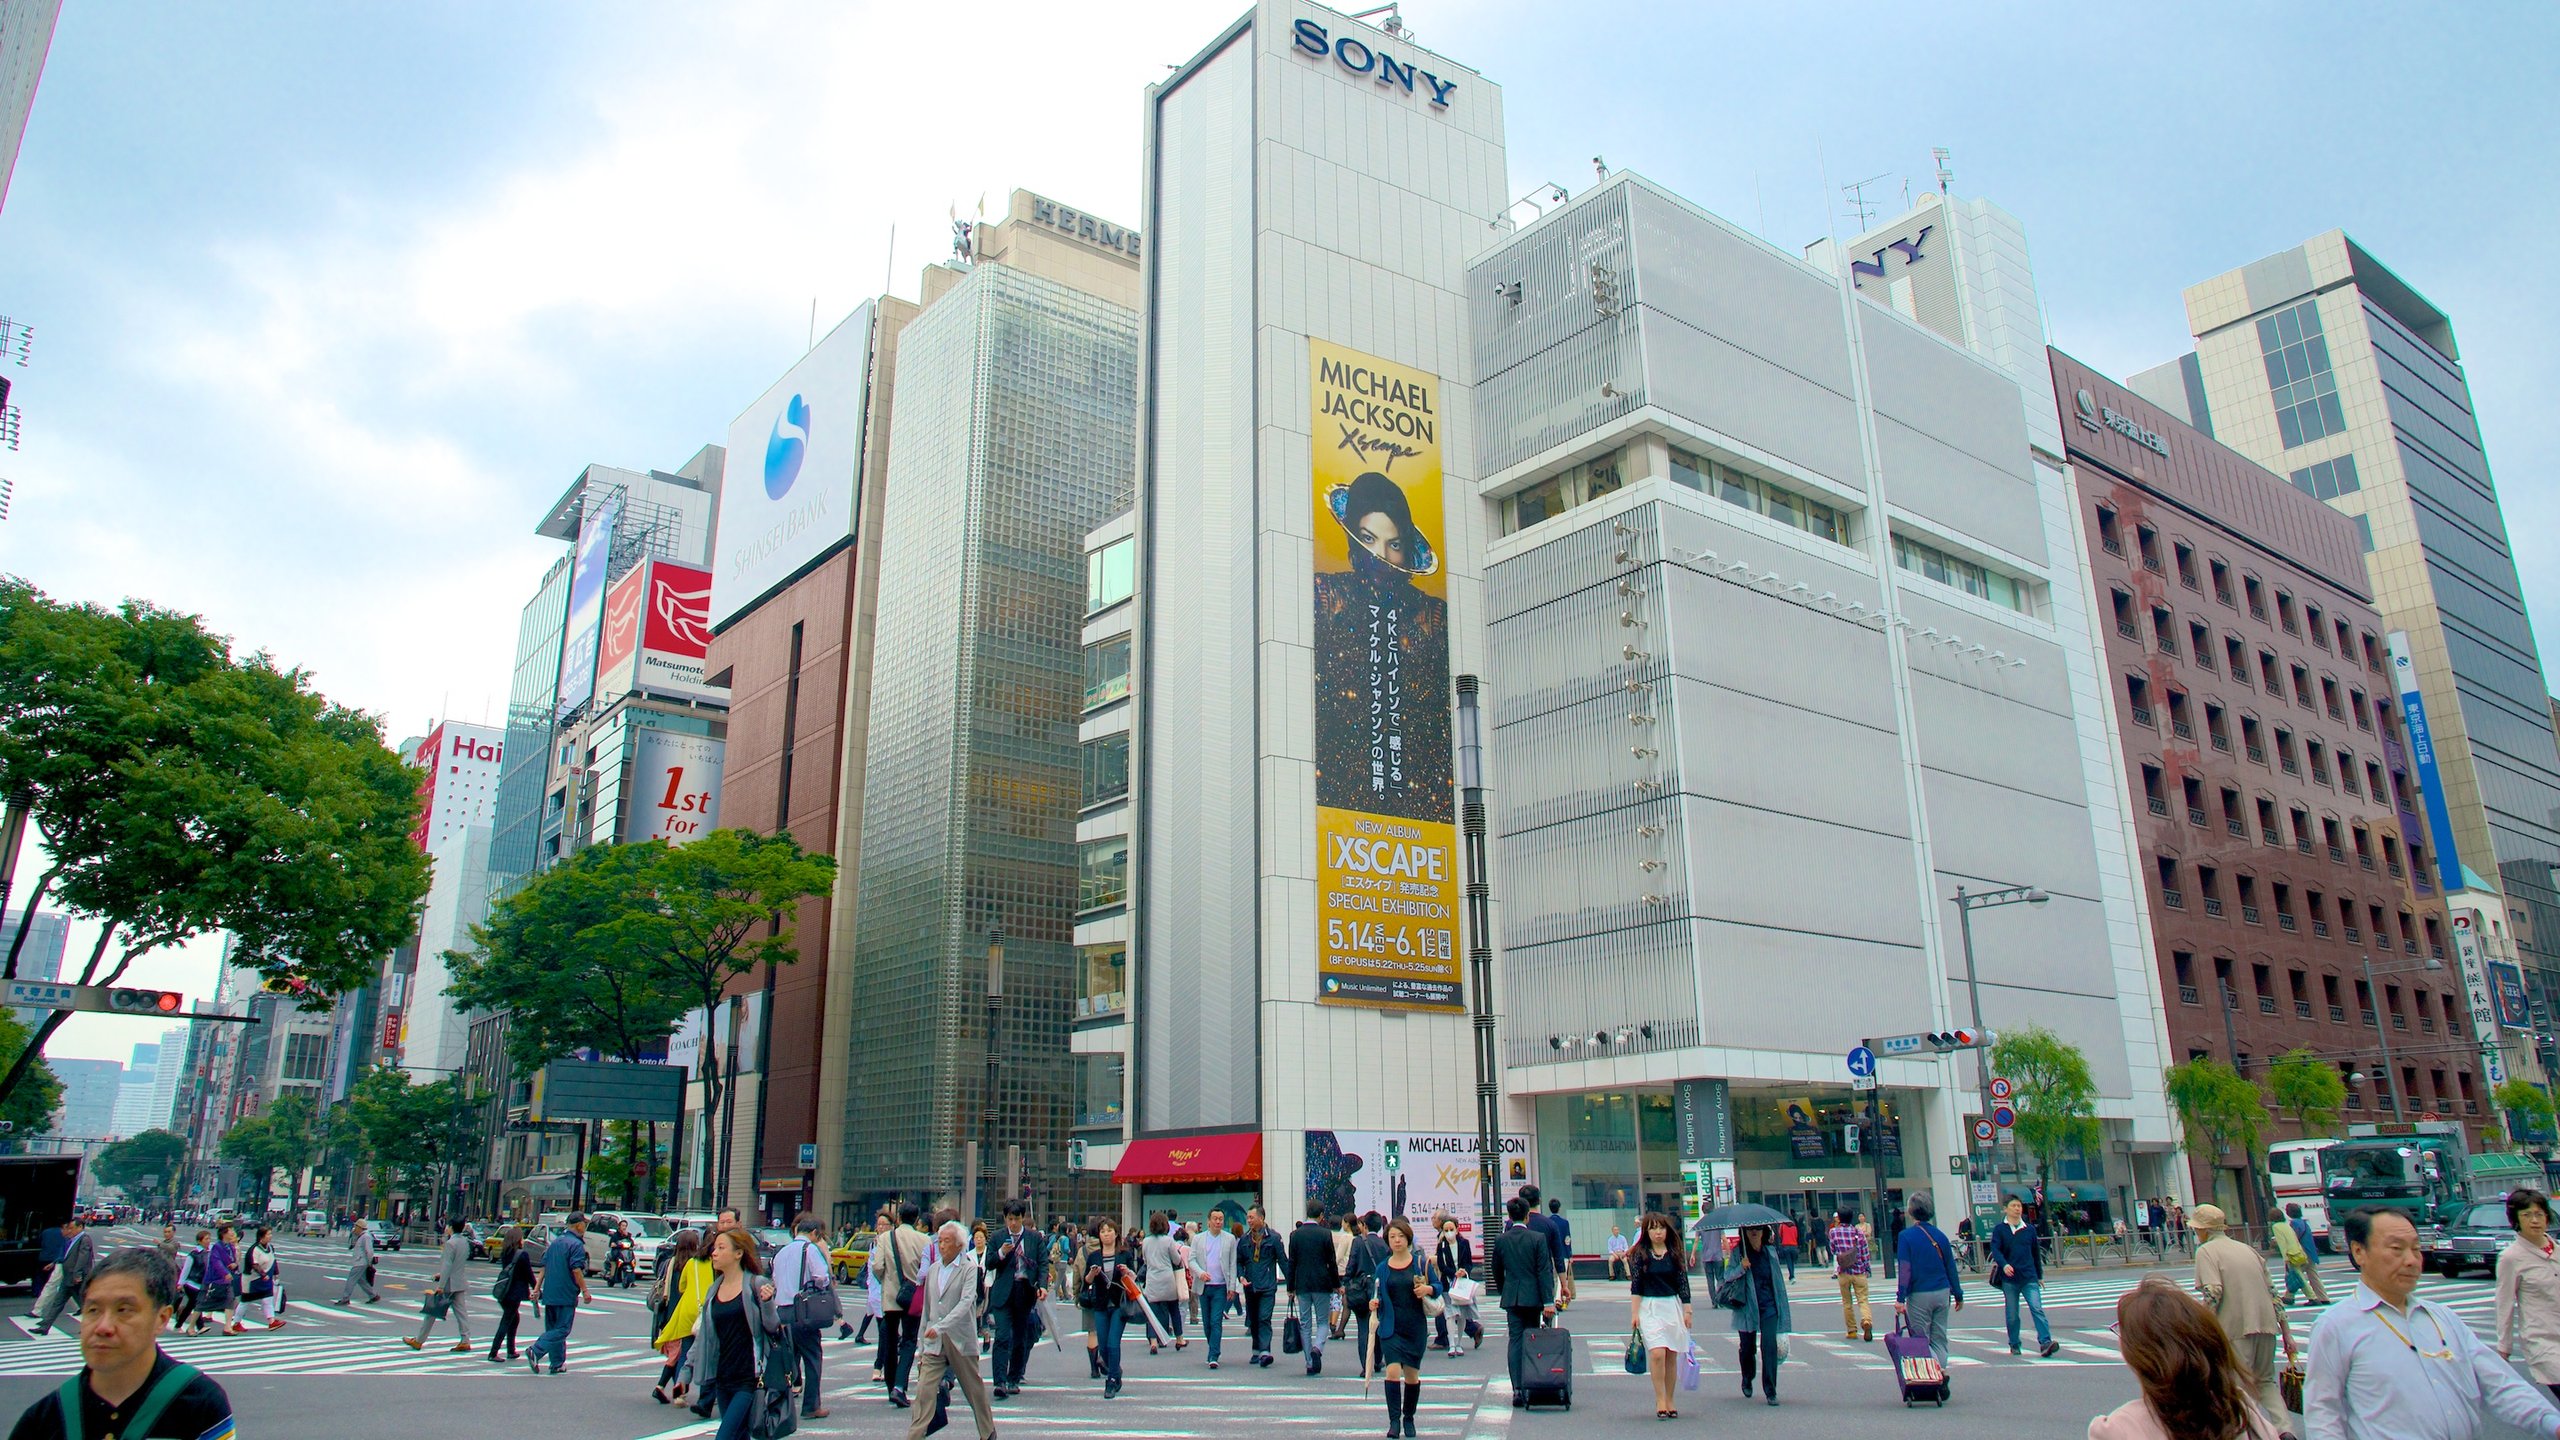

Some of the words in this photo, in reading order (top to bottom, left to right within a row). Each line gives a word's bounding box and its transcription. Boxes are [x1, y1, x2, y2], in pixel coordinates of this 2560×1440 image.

[1294, 18, 1458, 108] SONY
[1851, 225, 1933, 289] NY
[1320, 356, 1433, 415] MICHAEL
[1320, 390, 1433, 445] JACKSON
[733, 525, 785, 580] SHINSEI
[787, 488, 829, 543] BANK
[453, 735, 503, 763] Hai
[648, 736, 711, 752] あなたにとっての
[2407, 703, 2431, 765] 東京海上日動
[657, 766, 712, 814] 1st
[665, 814, 699, 834] for
[1355, 820, 1383, 834] NEW
[1386, 824, 1421, 840] ALBUM
[1328, 892, 1379, 912] SPECIAL
[1382, 898, 1450, 919] EXHIBITION
[1375, 923, 1385, 953] WED
[1426, 928, 1436, 957] SUN
[1341, 982, 1358, 991] Music
[1360, 984, 1387, 993] Unlimited
[2462, 946, 2492, 1023] 銀座熊本館
[671, 1037, 699, 1051] COACH
[1683, 1084, 1692, 1111] Sony
[1408, 1137, 1464, 1153] MICHAEL
[1685, 1113, 1694, 1155] Building
[1716, 1112, 1726, 1154] Building
